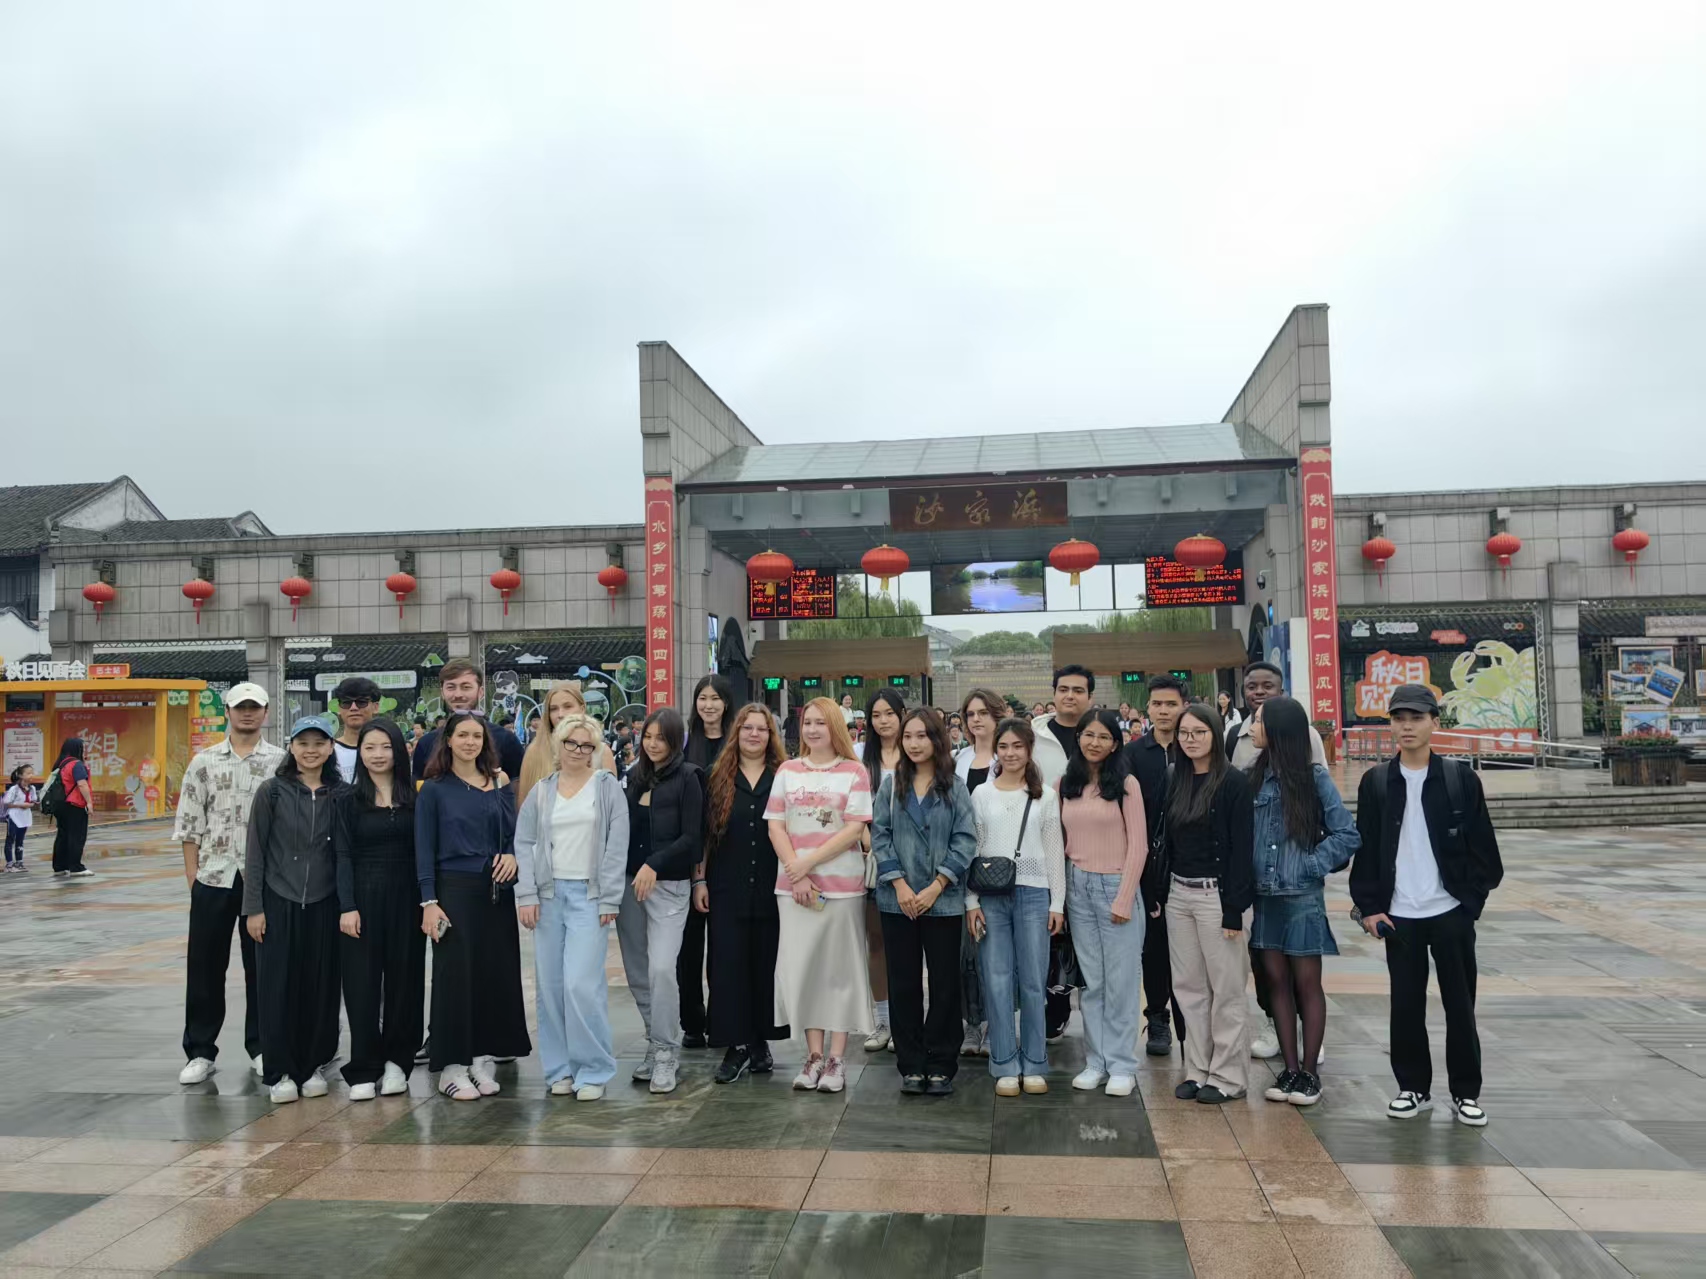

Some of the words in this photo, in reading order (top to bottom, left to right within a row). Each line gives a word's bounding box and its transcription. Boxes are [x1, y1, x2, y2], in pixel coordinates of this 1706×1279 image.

[914, 488, 1041, 525] 沙家浜
[1309, 493, 1334, 714] 戏韵沙家浜现一派风光
[6, 660, 85, 680] 秋日见面会
[1371, 656, 1424, 685] 秋日
[76, 728, 119, 753] 秋日
[84, 752, 126, 776] 面会
